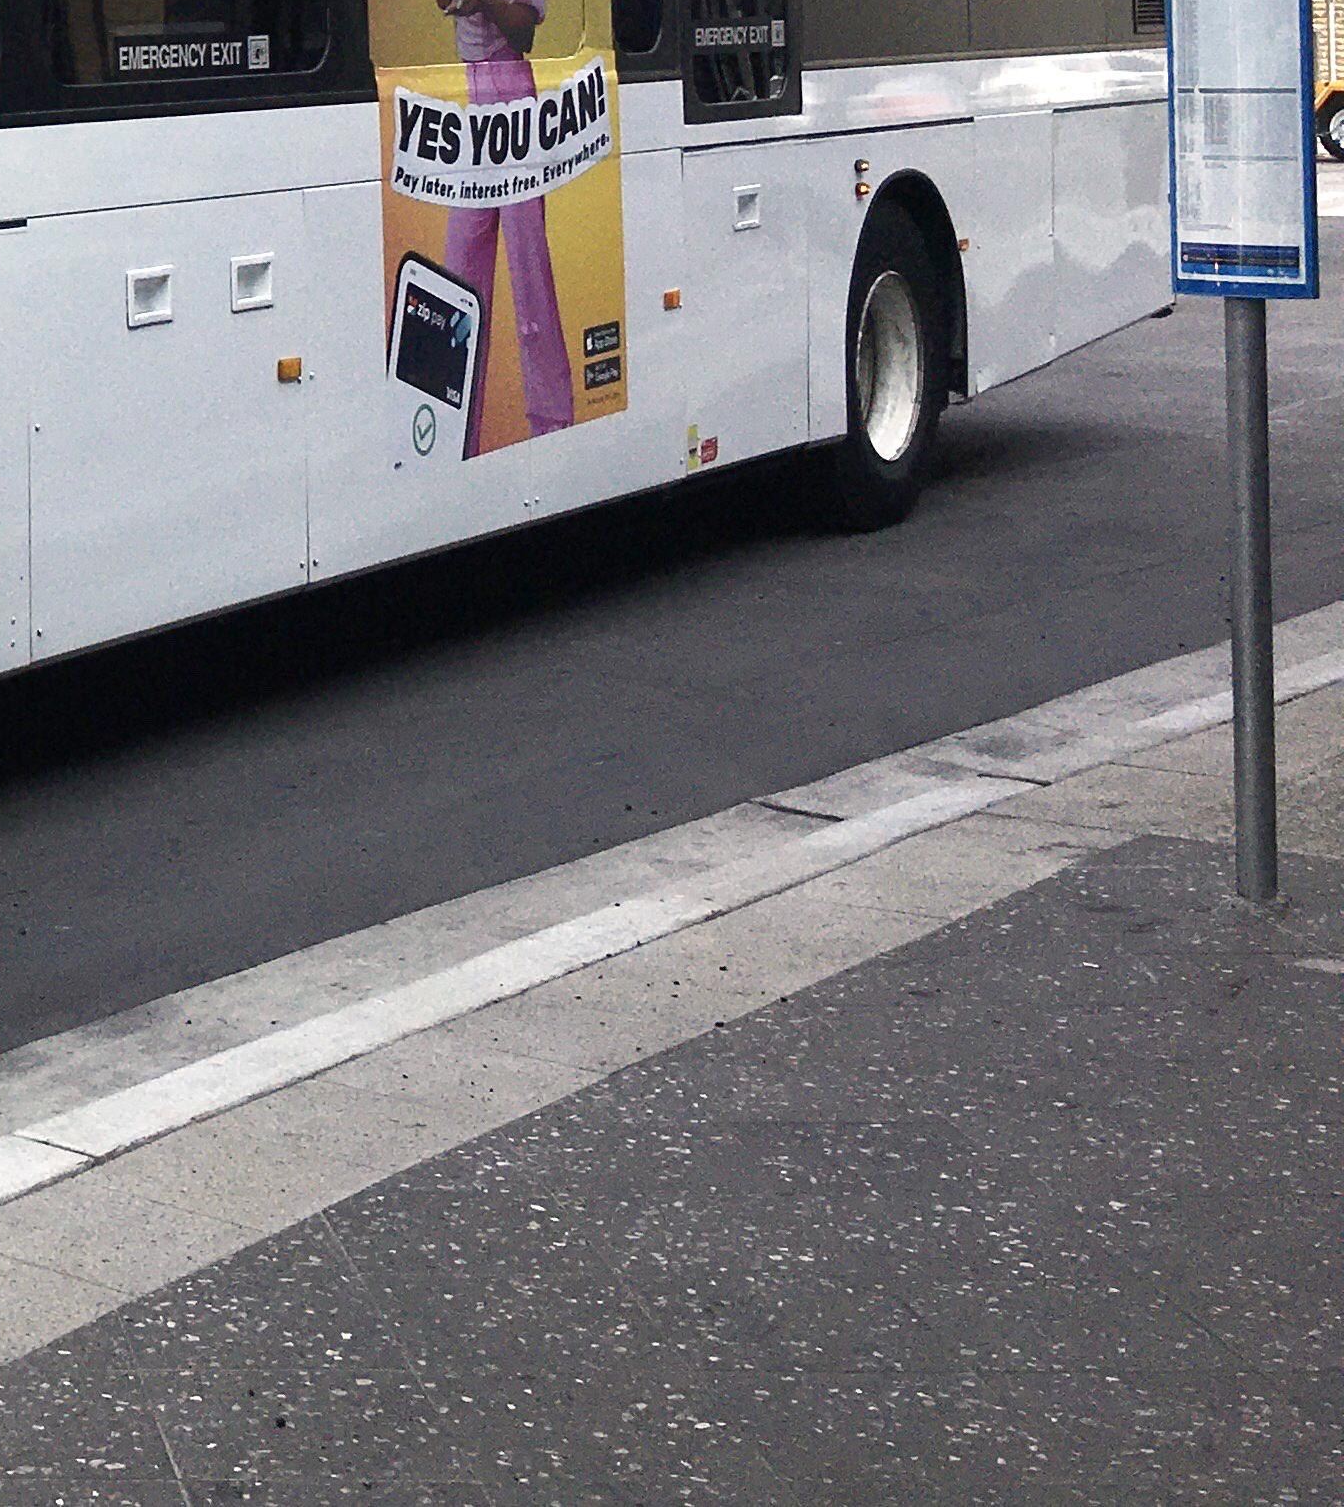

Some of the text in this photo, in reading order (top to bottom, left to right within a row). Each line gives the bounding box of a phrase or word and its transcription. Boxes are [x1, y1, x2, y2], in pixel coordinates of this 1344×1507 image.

[694, 25, 769, 47] EMERGENCY EXIT
[118, 41, 244, 71] EMERGENCY EXIT
[398, 64, 607, 166] YES YOU CAN!
[394, 132, 611, 200] Pay later, interest free. Everywhere.
[416, 301, 432, 323] zip
